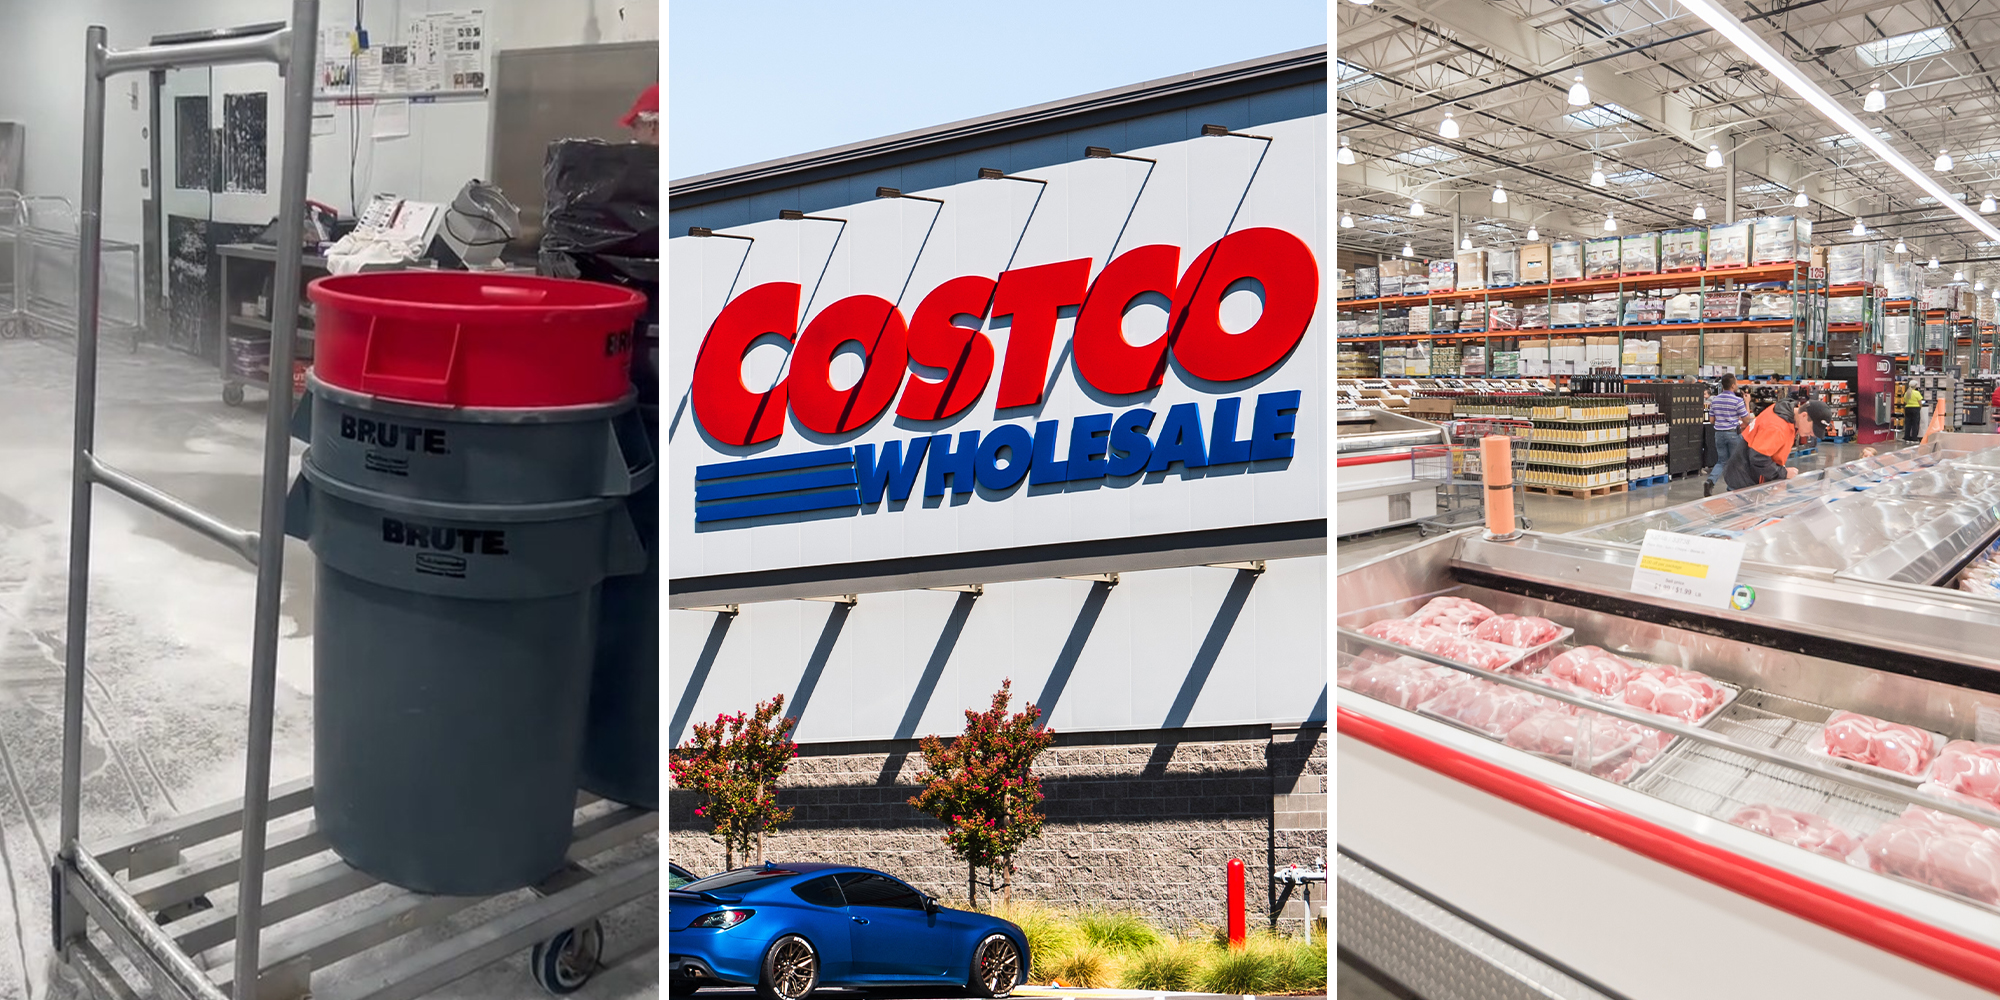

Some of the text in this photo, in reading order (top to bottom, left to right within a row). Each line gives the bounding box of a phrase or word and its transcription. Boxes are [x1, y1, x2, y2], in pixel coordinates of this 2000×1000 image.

[692, 227, 1319, 446] COSTCO
[341, 414, 449, 454] BRUTE
[856, 390, 1301, 502] WHOLESALE
[383, 517, 508, 555] BRUTE
